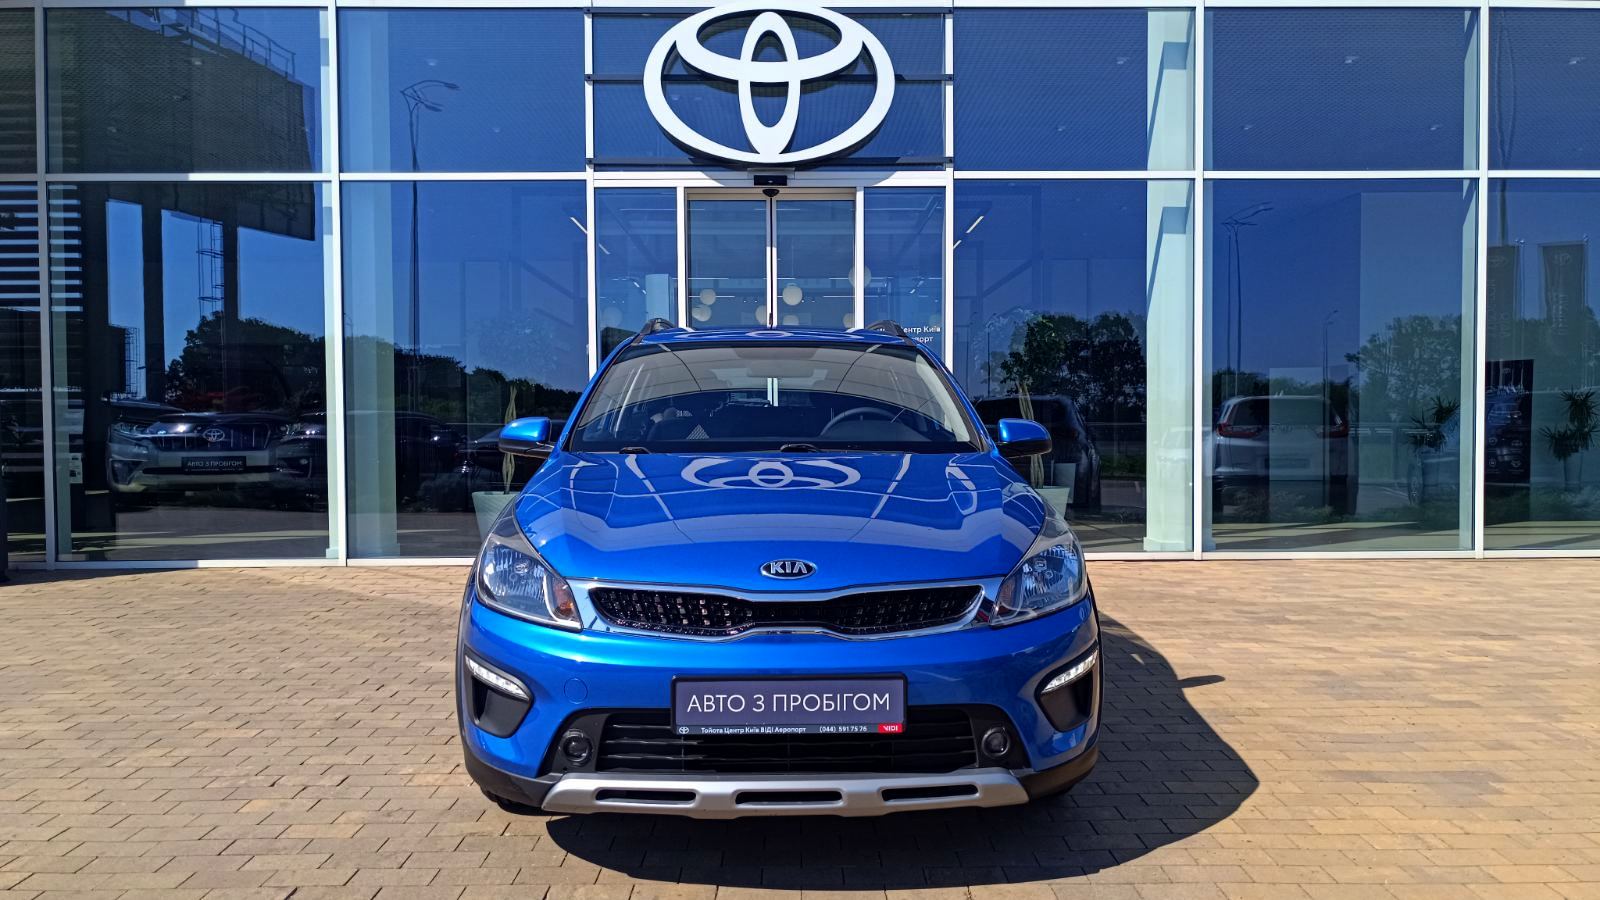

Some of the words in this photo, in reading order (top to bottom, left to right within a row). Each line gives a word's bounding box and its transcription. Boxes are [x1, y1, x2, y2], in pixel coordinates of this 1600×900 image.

[901, 325, 921, 334] ентр
[770, 561, 808, 574] KIA
[687, 694, 745, 712] АВТО
[773, 693, 890, 711] ПРОБІГОМ
[724, 727, 745, 735] Центр
[774, 726, 807, 734] Аеропорт
[819, 725, 836, 733] (044)
